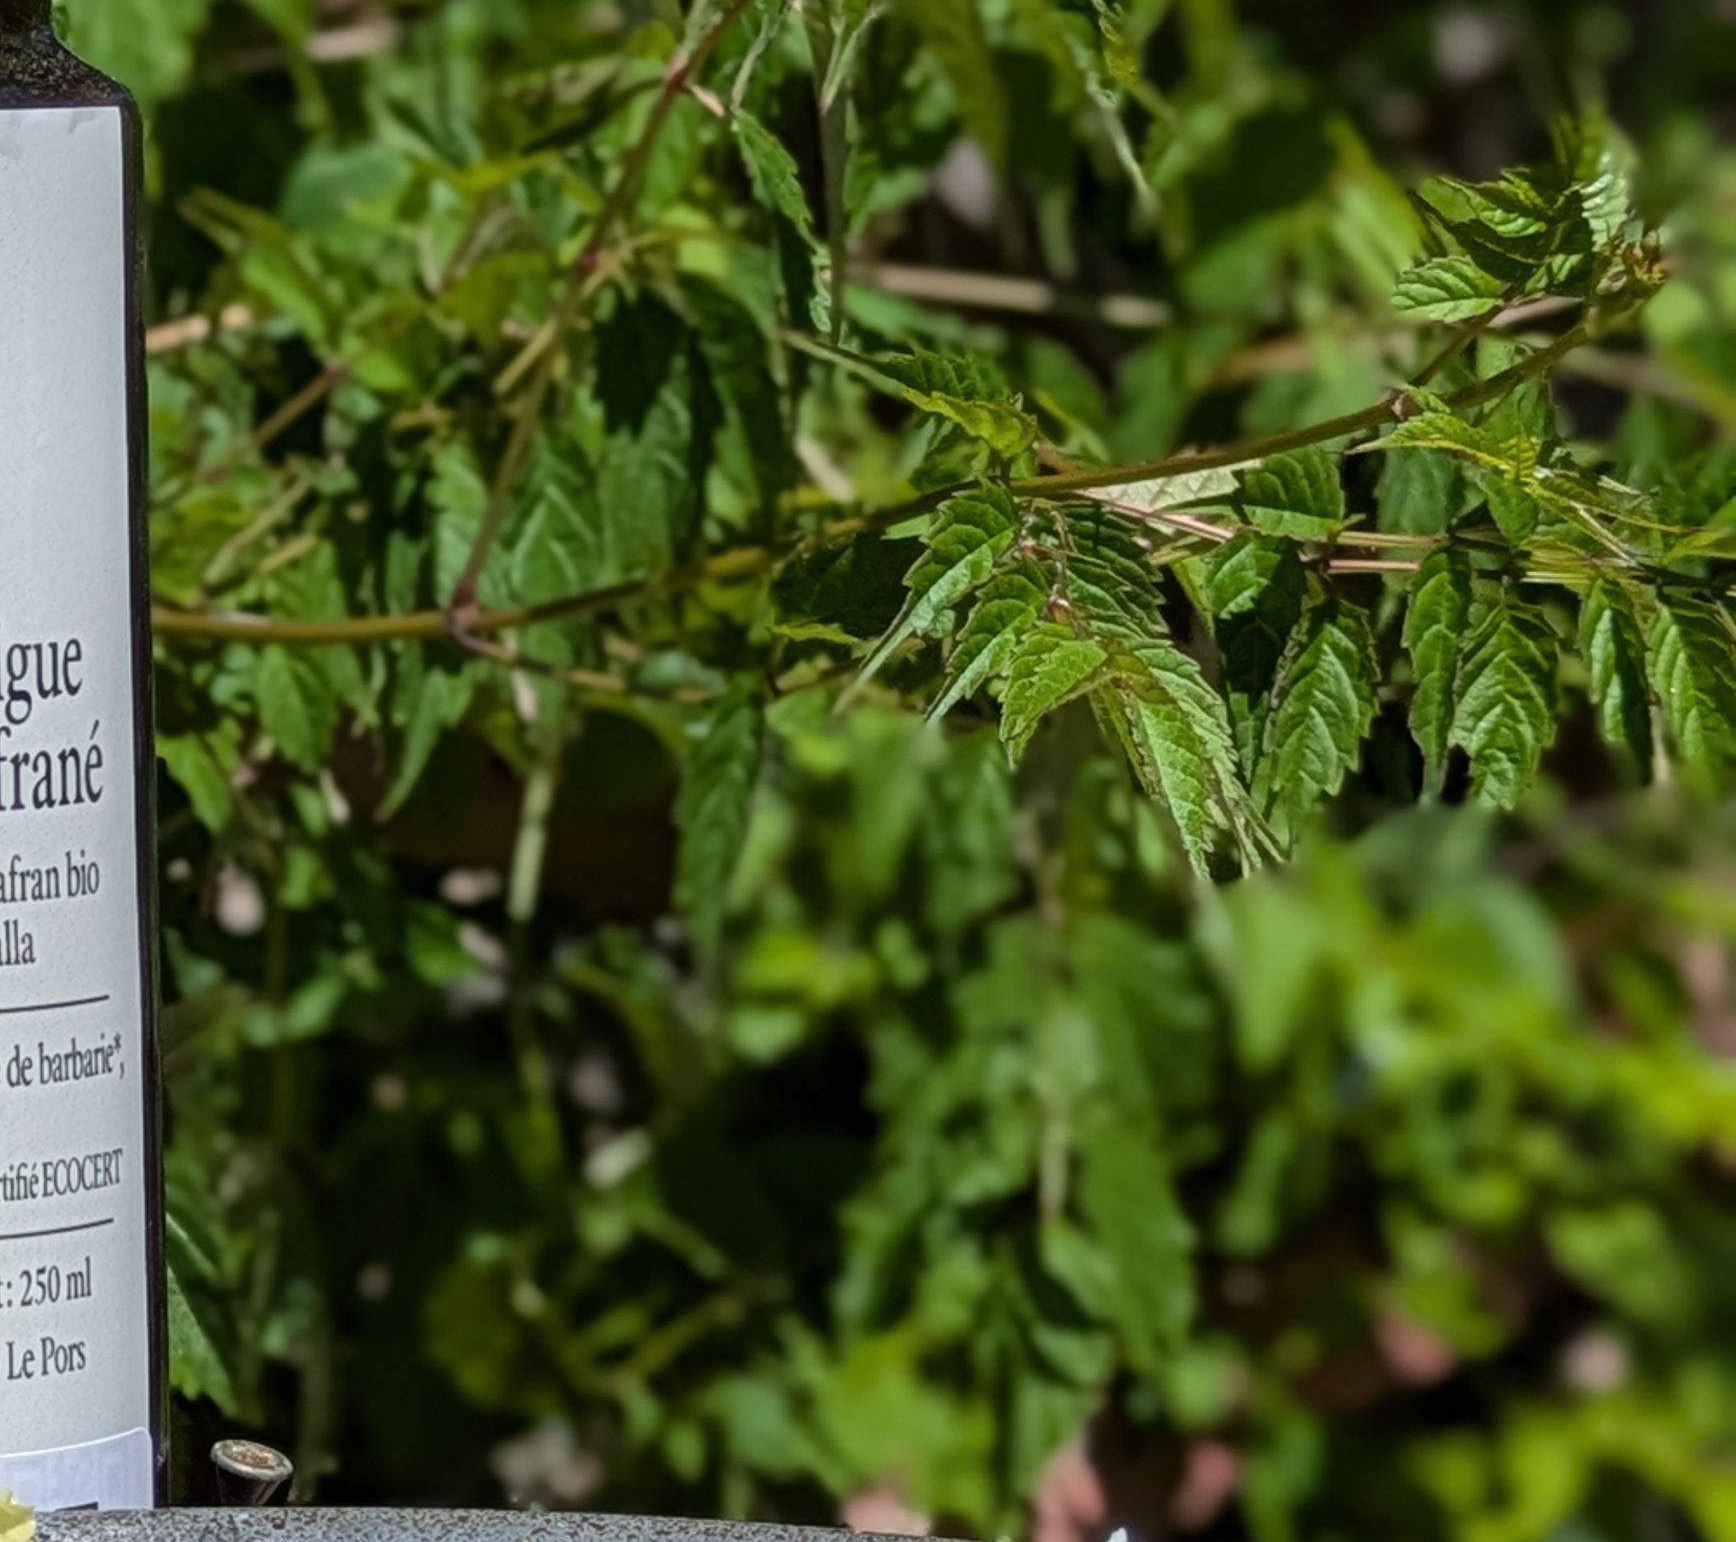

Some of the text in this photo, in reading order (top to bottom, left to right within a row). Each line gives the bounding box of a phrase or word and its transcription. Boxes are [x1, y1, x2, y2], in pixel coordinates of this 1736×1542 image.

[66, 849, 100, 897] bio
[6, 1044, 33, 1088] de
[42, 1148, 123, 1197] ECOCERT
[20, 1267, 61, 1308] 250
[66, 1256, 92, 1300] ml
[6, 1341, 36, 1380] Le
[40, 1336, 86, 1375] Pors
